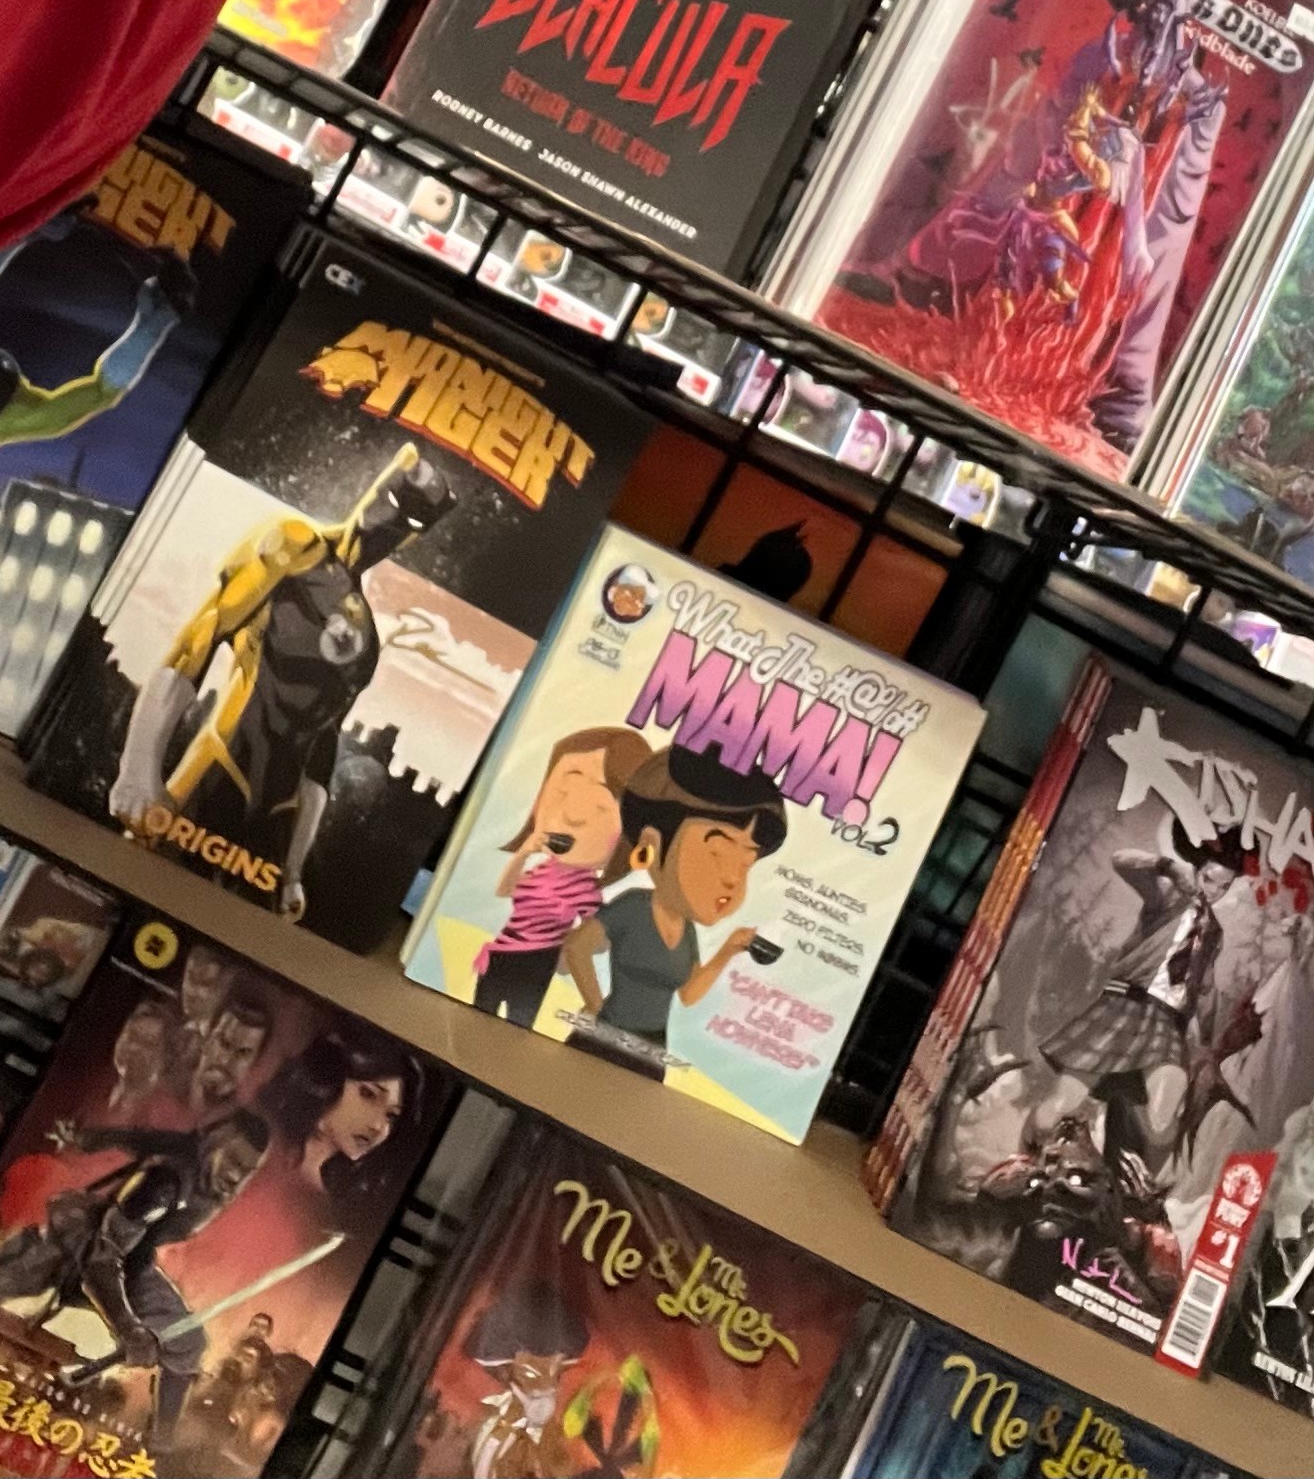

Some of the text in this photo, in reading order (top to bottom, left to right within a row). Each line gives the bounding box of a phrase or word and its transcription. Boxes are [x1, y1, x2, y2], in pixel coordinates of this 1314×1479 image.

[431, 88, 699, 241] RODNEY BARNES JASON SHAWN ALEXANDER
[667, 580, 766, 662] What
[749, 633, 827, 695] The
[624, 627, 904, 827] MAMA!
[143, 804, 283, 894] ORIGINS
[865, 817, 900, 856] 2
[553, 1179, 644, 1288] Me
[943, 1354, 1029, 1458] Me
